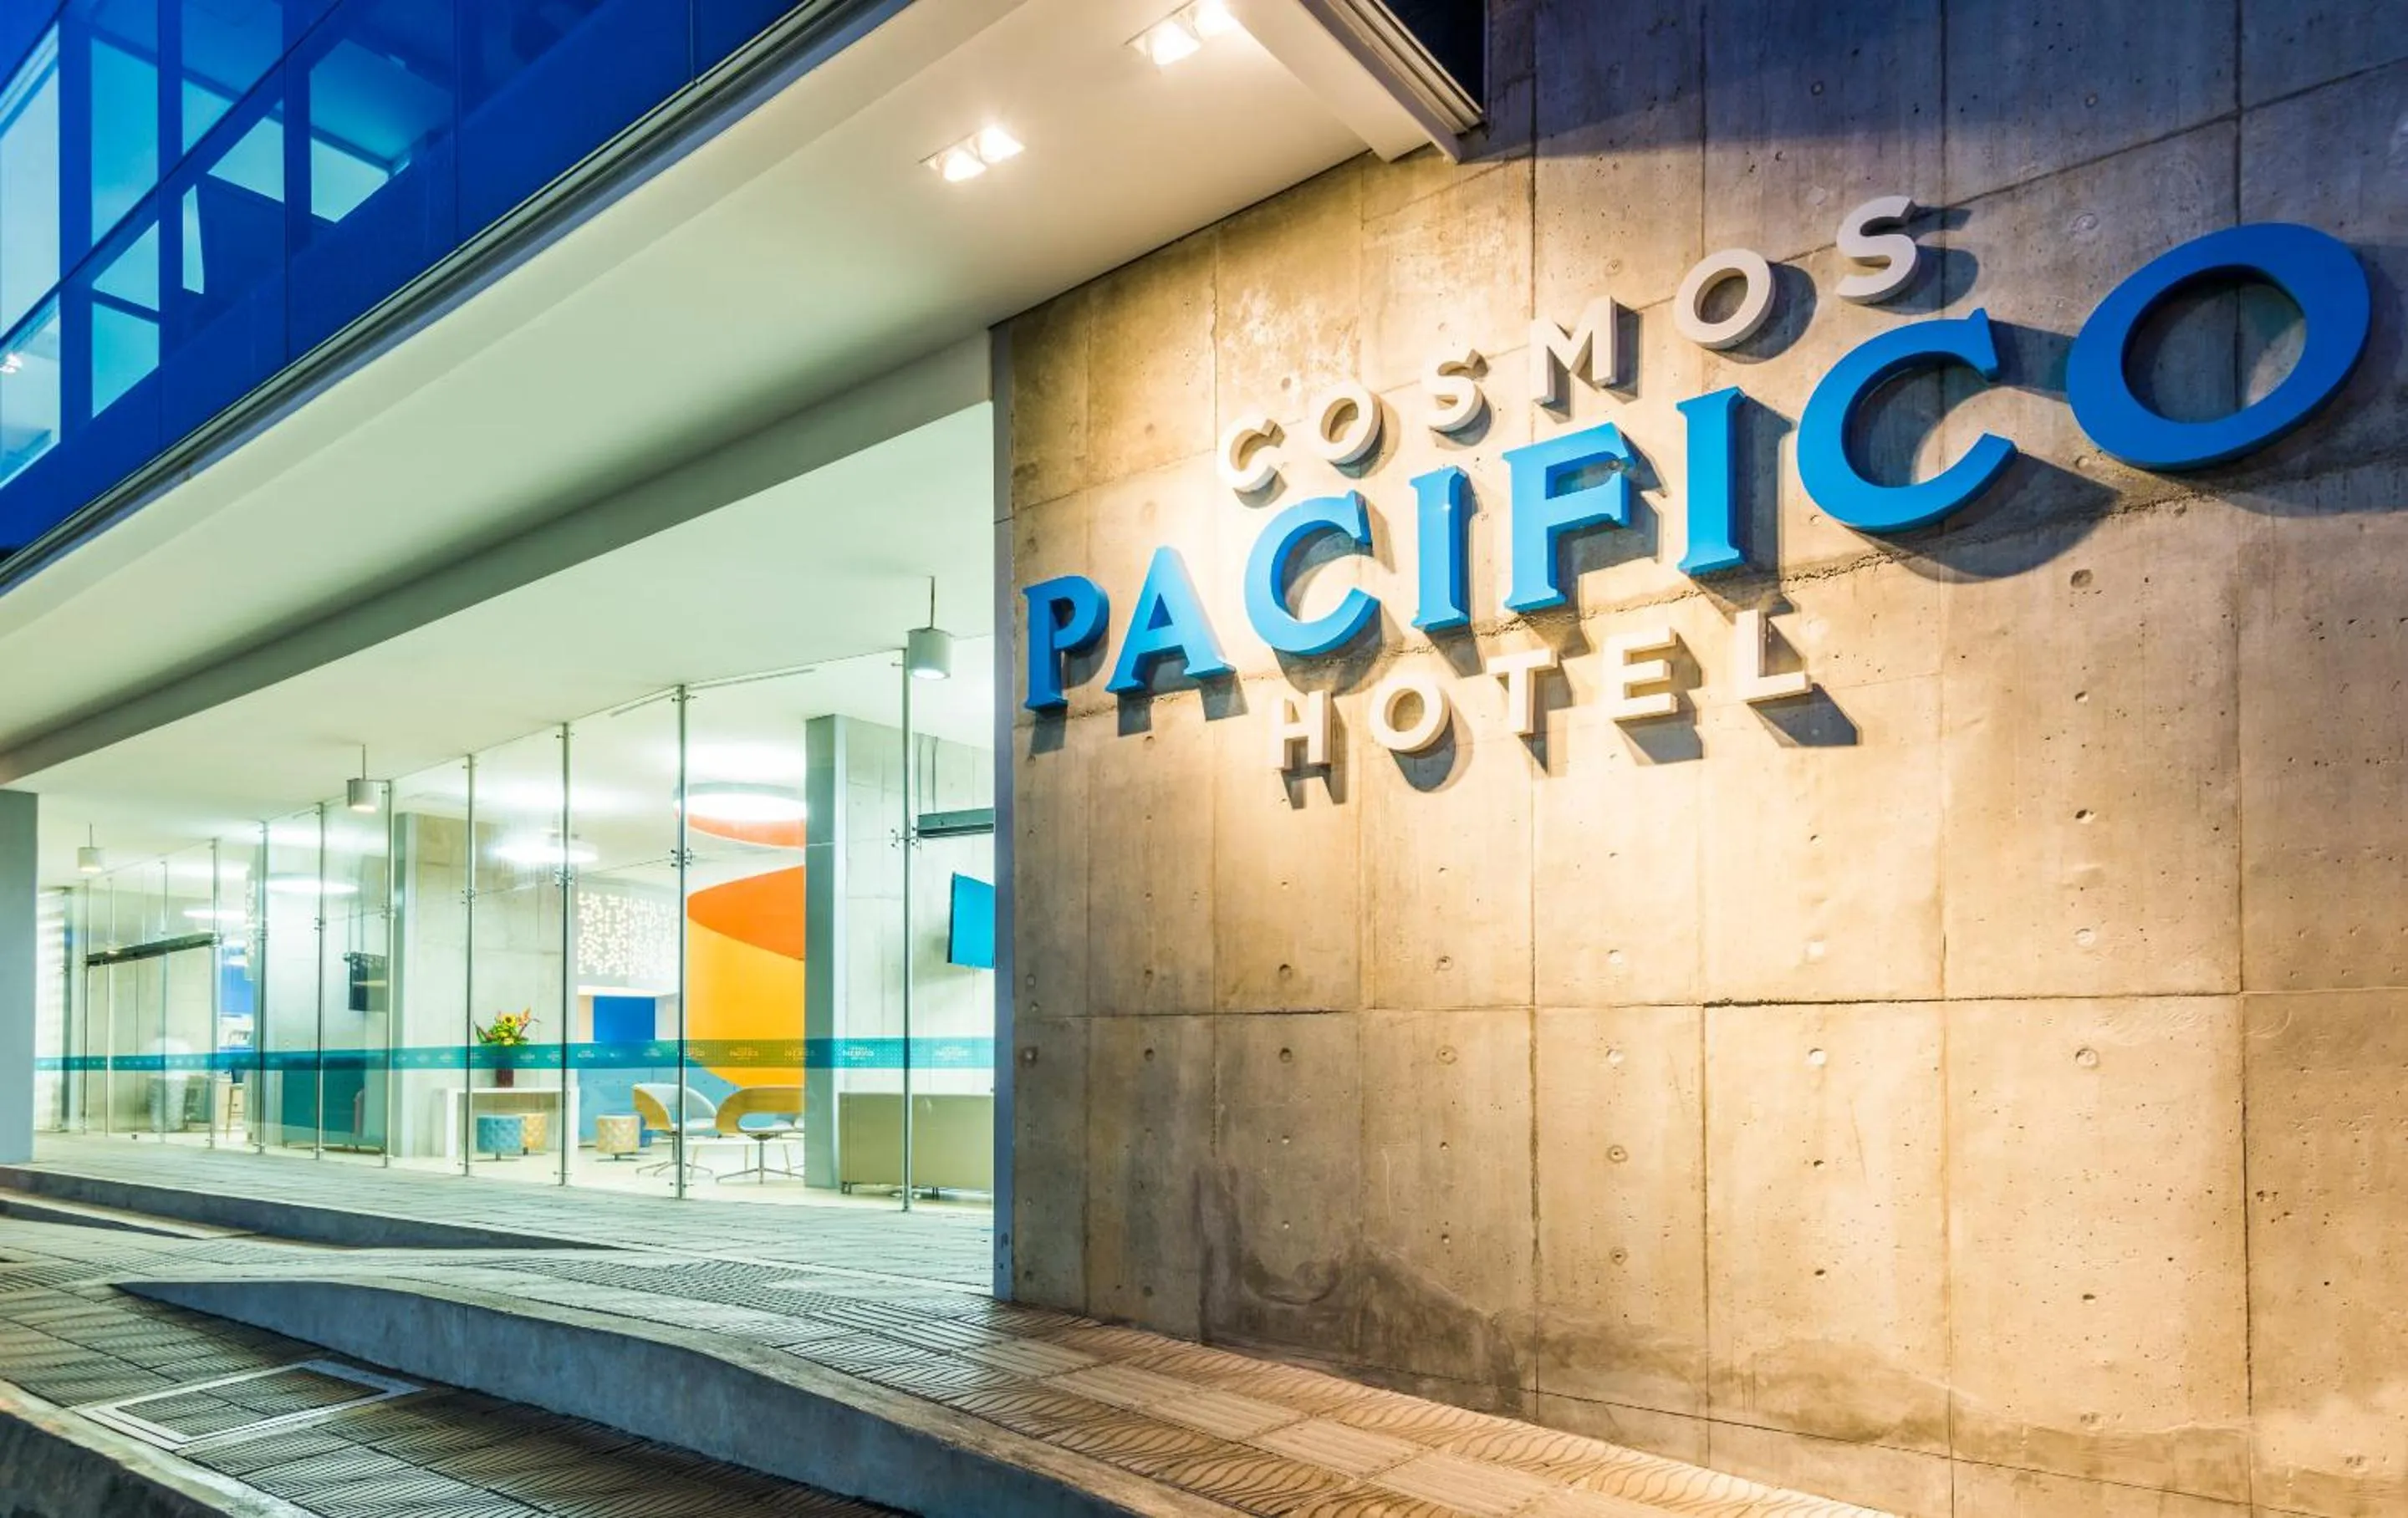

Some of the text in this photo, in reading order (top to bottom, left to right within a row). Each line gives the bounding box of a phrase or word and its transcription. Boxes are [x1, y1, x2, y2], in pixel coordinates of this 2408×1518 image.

[1022, 222, 2372, 711] PACIFICO
[1217, 195, 1920, 493] COSMOS
[1272, 609, 1813, 771] HOTEL
